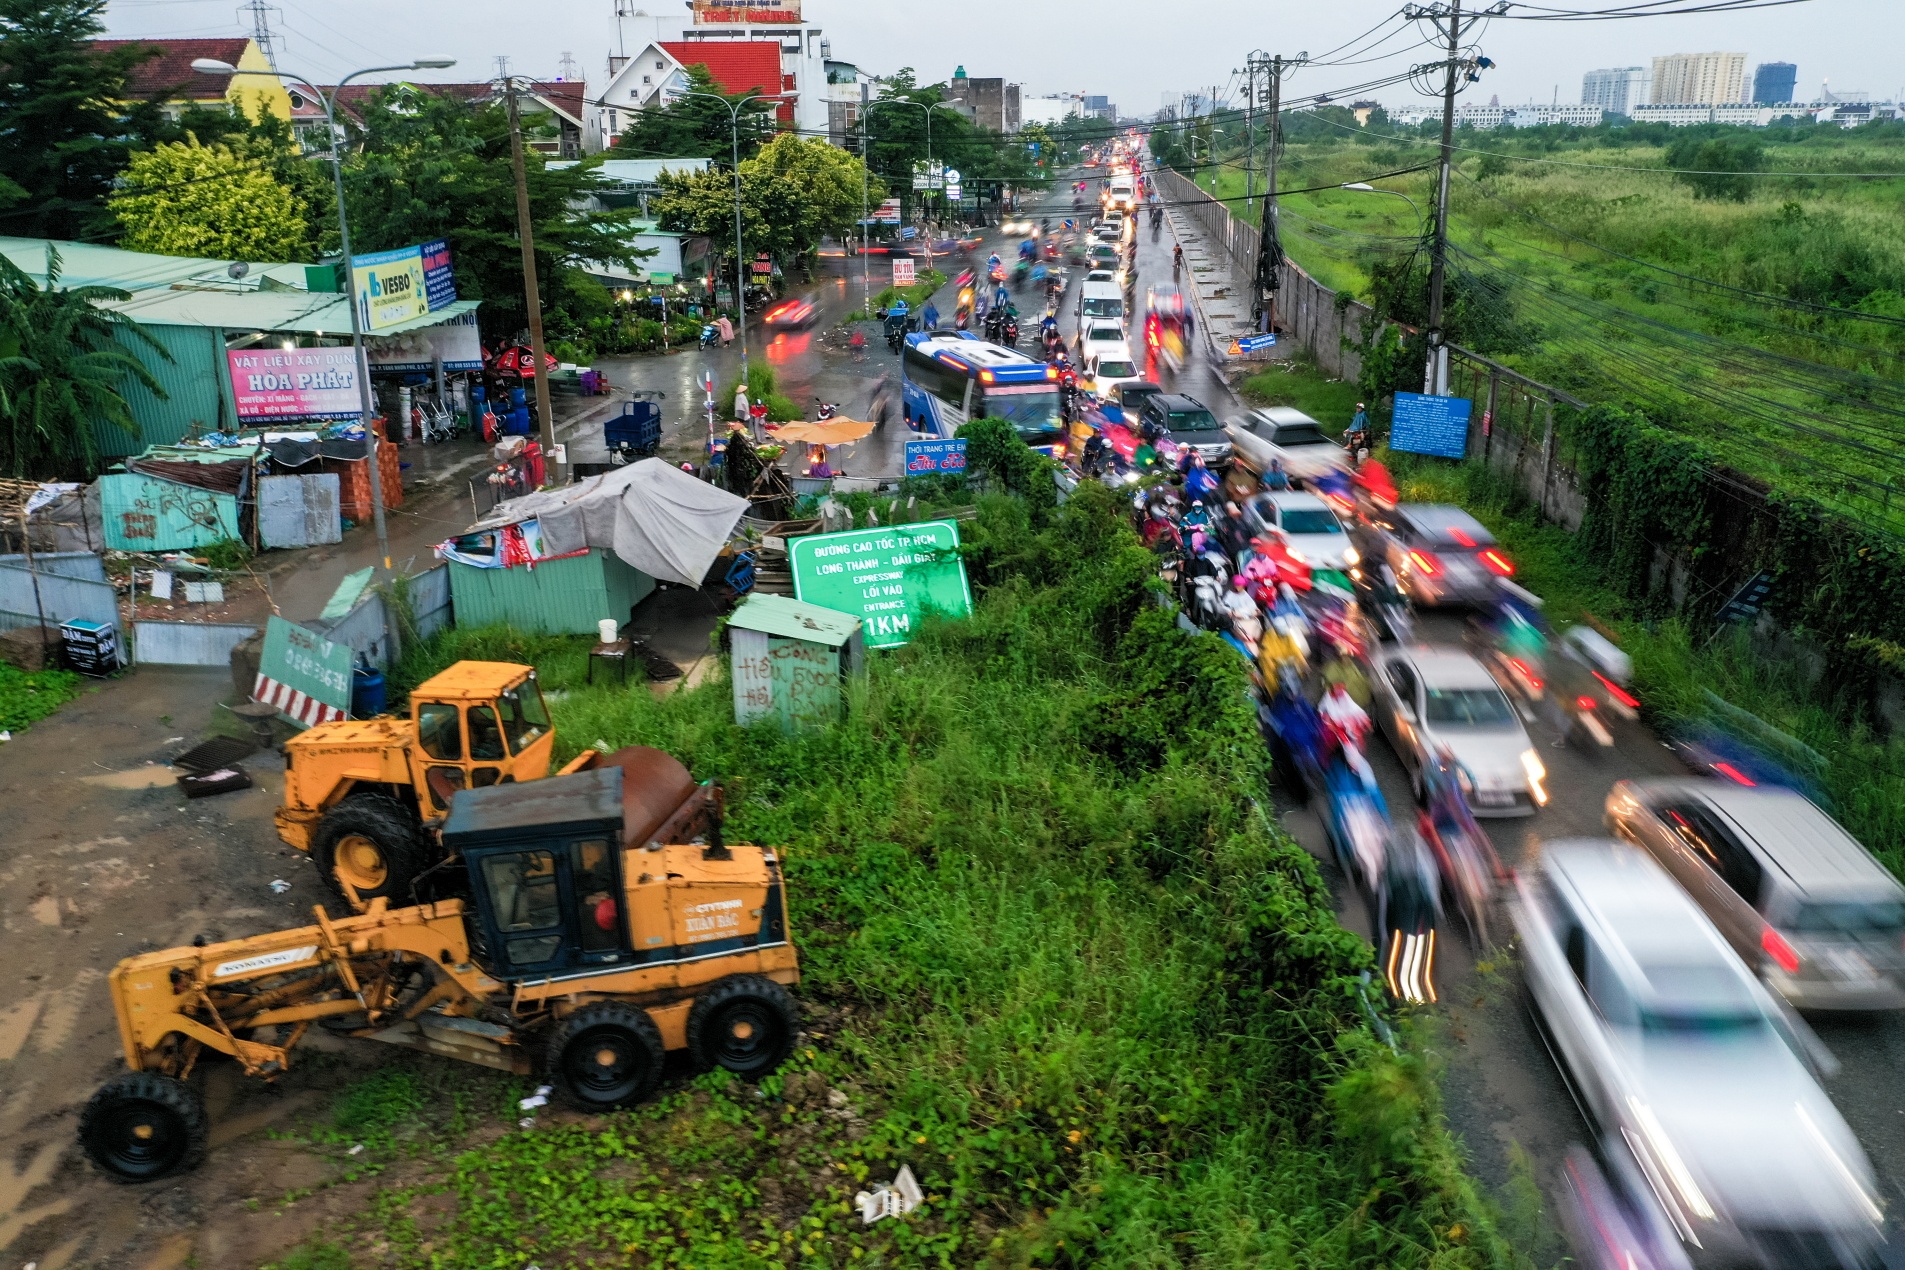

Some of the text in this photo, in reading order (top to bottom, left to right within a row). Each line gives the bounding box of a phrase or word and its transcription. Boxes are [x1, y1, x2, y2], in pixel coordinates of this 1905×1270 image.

[382, 273, 410, 295] VESBO
[234, 354, 259, 371] VẬT
[263, 353, 293, 370] LIỆU
[296, 352, 321, 366] XÂY
[247, 368, 352, 392] HÒA PHÁT
[238, 395, 266, 404] CHUYÊN:
[275, 393, 295, 403] MĂNG
[239, 406, 250, 415] XÀ
[908, 441, 966, 454] THỜI TRANG TRẺ EM
[814, 534, 936, 558] ĐƯỜNG CAO TỐC TP. HCM
[815, 563, 844, 576] LONG
[845, 557, 879, 572] THÀNH
[853, 571, 904, 585] EXPRESSWAY
[862, 583, 903, 599] LỐI VÀO
[863, 600, 906, 613] ENTRANCE
[865, 613, 910, 637] 1KM
[223, 953, 291, 972] KOMATSU
